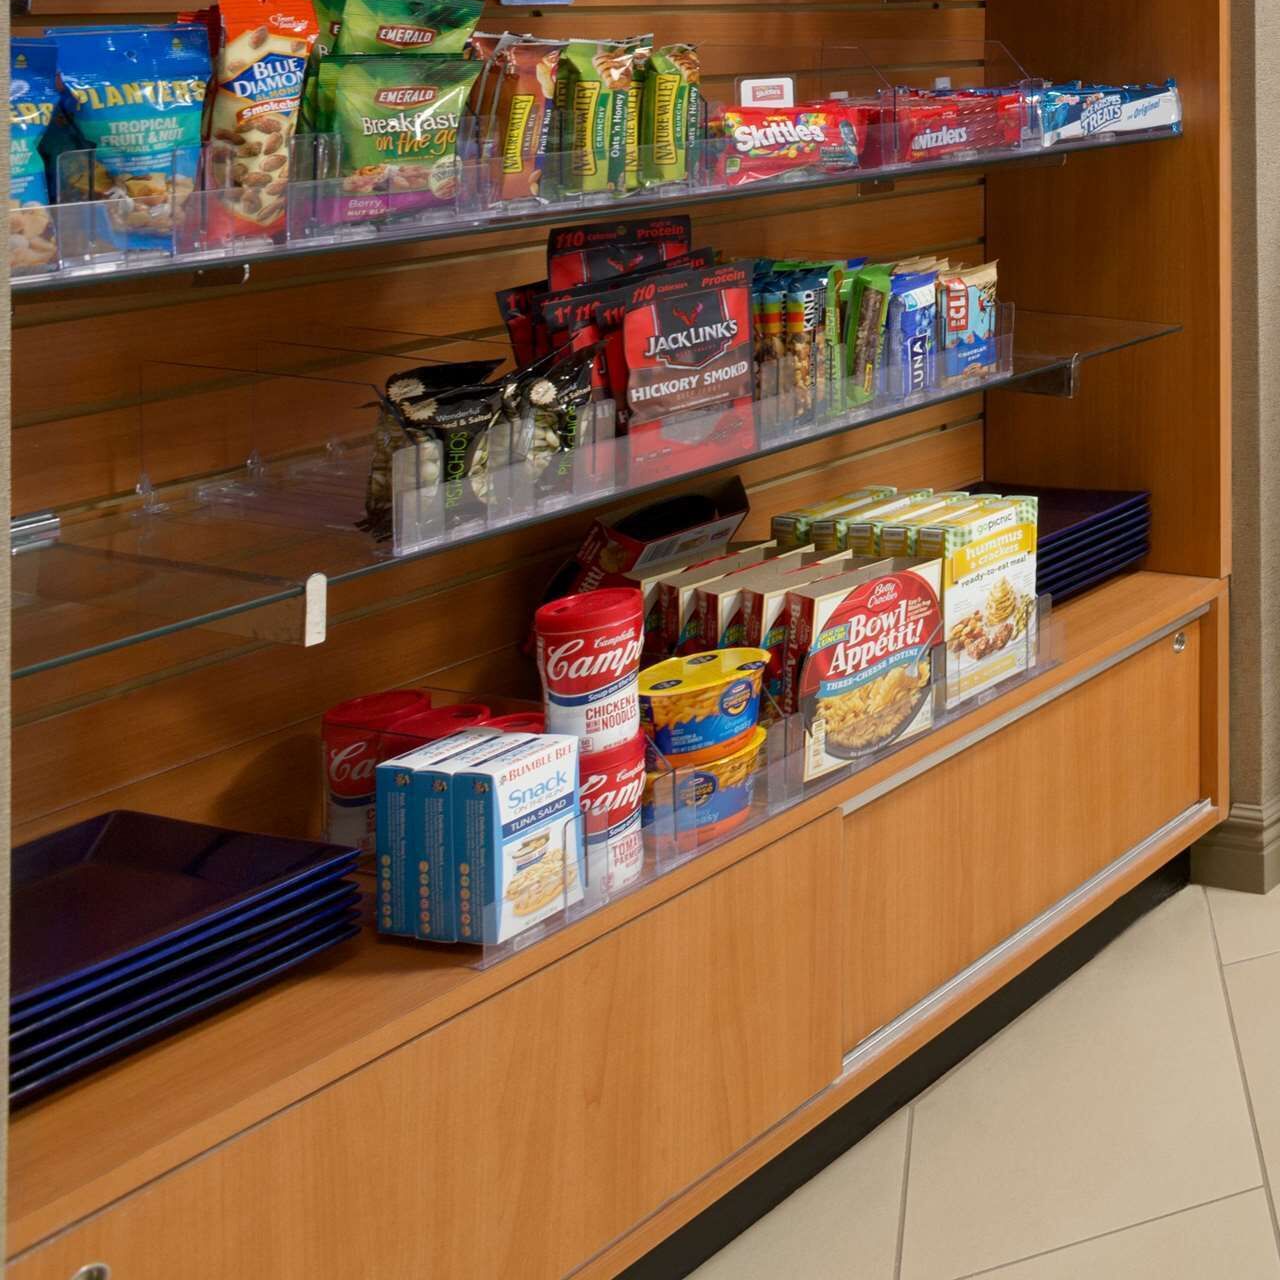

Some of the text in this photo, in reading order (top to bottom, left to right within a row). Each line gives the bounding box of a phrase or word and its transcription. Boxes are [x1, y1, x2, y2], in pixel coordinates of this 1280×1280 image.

[379, 27, 433, 43] EMERALD
[234, 70, 304, 99] DIAMON
[253, 58, 301, 81] BLUE
[70, 79, 207, 111] PLANTERS
[378, 90, 434, 105] EMERALD
[100, 131, 145, 148] FRUIT
[160, 127, 185, 142] NUT
[109, 117, 180, 135] TROPICAL
[362, 112, 459, 136] Breakfast
[611, 93, 626, 158] Oats Honey
[735, 120, 825, 151] Skittles
[375, 135, 393, 152] on
[397, 130, 431, 154] the
[632, 270, 745, 303] 110 Protein
[803, 290, 815, 332] KIND
[645, 320, 738, 357] JACK LINK'S
[912, 340, 925, 391] LUNA
[631, 361, 748, 403] HICKORY SMOKED
[436, 407, 481, 422] Wonderful
[873, 581, 896, 597] Betty
[848, 599, 908, 647] Bowl
[827, 618, 924, 677] Appétit!
[585, 697, 629, 721] CHICKEN
[602, 706, 637, 731] NOODLES
[508, 771, 567, 808] Snack
[510, 799, 567, 831] TUNA SALAD
